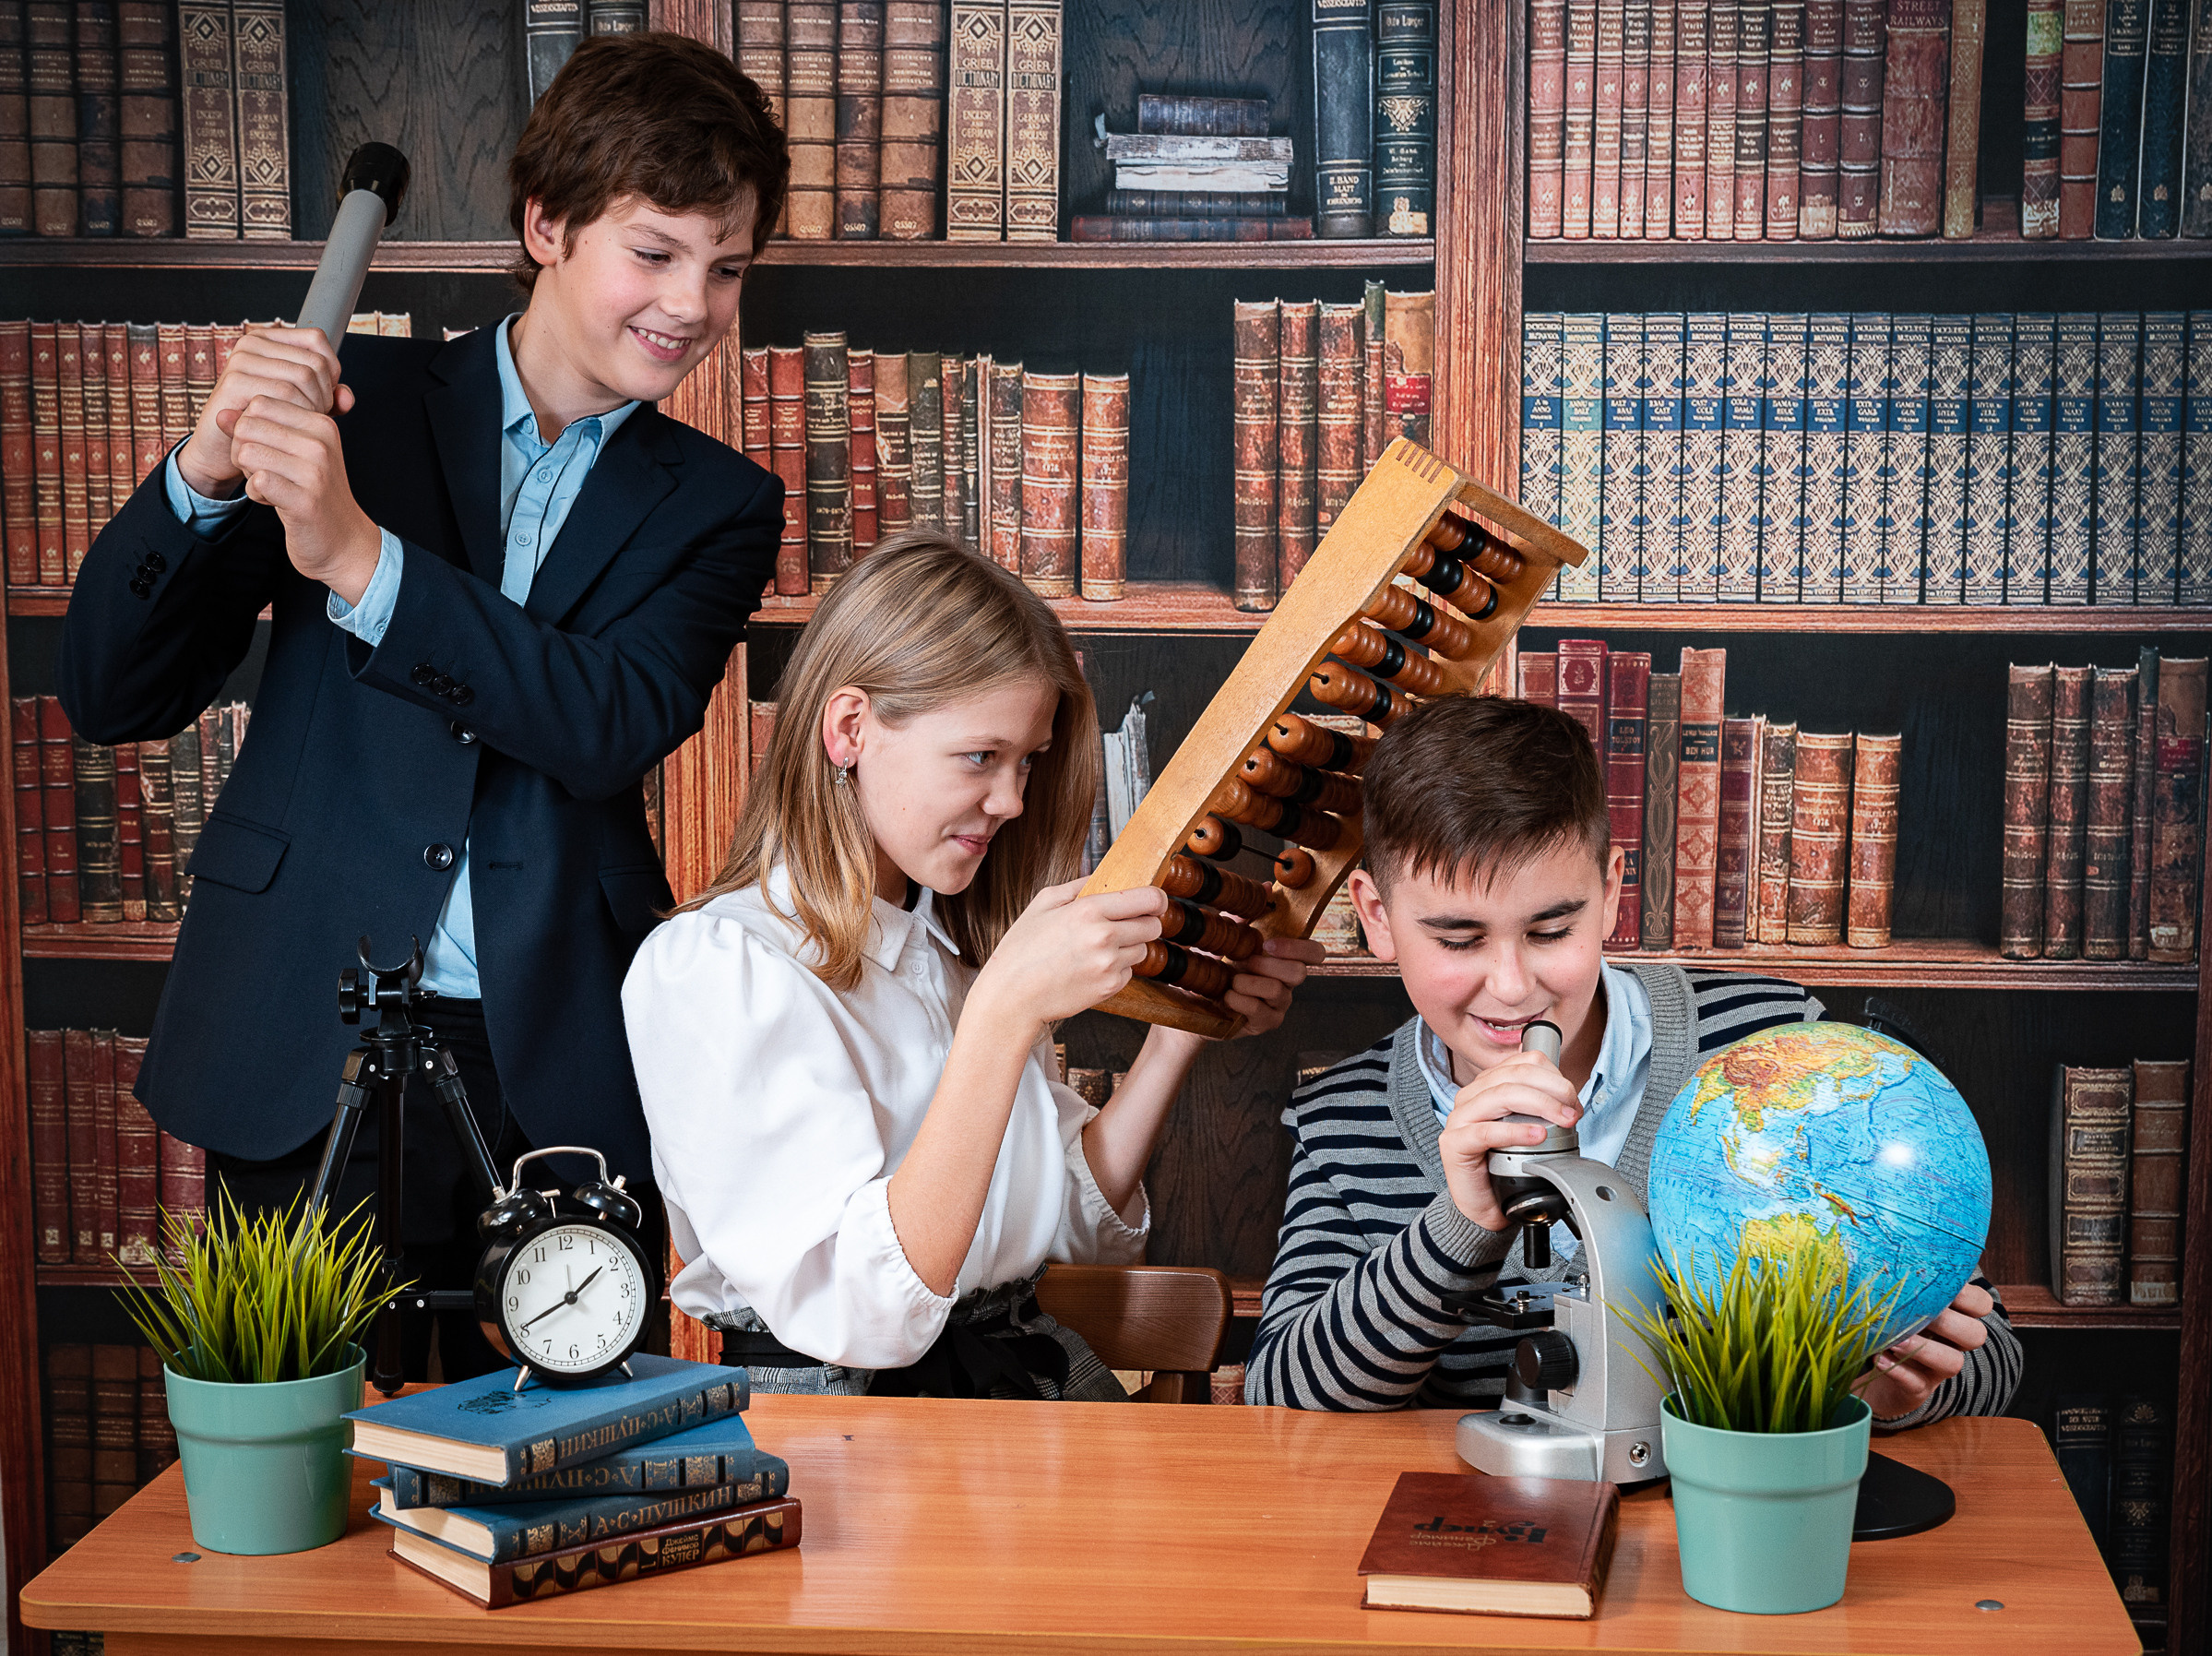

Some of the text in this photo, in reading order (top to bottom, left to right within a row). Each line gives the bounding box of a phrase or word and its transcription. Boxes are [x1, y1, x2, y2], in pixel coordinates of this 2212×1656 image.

[1897, 0, 1942, 12] STREET
[1889, 15, 1945, 27] RAILWAYS
[957, 70, 1000, 88] DICTIONARY
[1013, 73, 1056, 90] DICTIONARY
[1619, 726, 1635, 734] LEO
[1611, 736, 1641, 745] TOLSTOY
[1685, 746, 1715, 756] BEN HUR
[558, 1235, 573, 1250] 12
[589, 1240, 596, 1255] 1
[534, 1247, 546, 1263] 11
[609, 1257, 619, 1271] 2
[517, 1269, 531, 1285] 10
[621, 1283, 630, 1298] 3
[508, 1296, 518, 1312] 9
[612, 1310, 623, 1326] 4
[520, 1322, 530, 1338] 8
[542, 1339, 552, 1354] 7
[597, 1333, 606, 1349] 5
[569, 1344, 579, 1360] 6
[1413, 1516, 1549, 1543] Купер
[665, 1534, 699, 1547] Джеймс
[661, 1549, 700, 1567] КУПЕР
